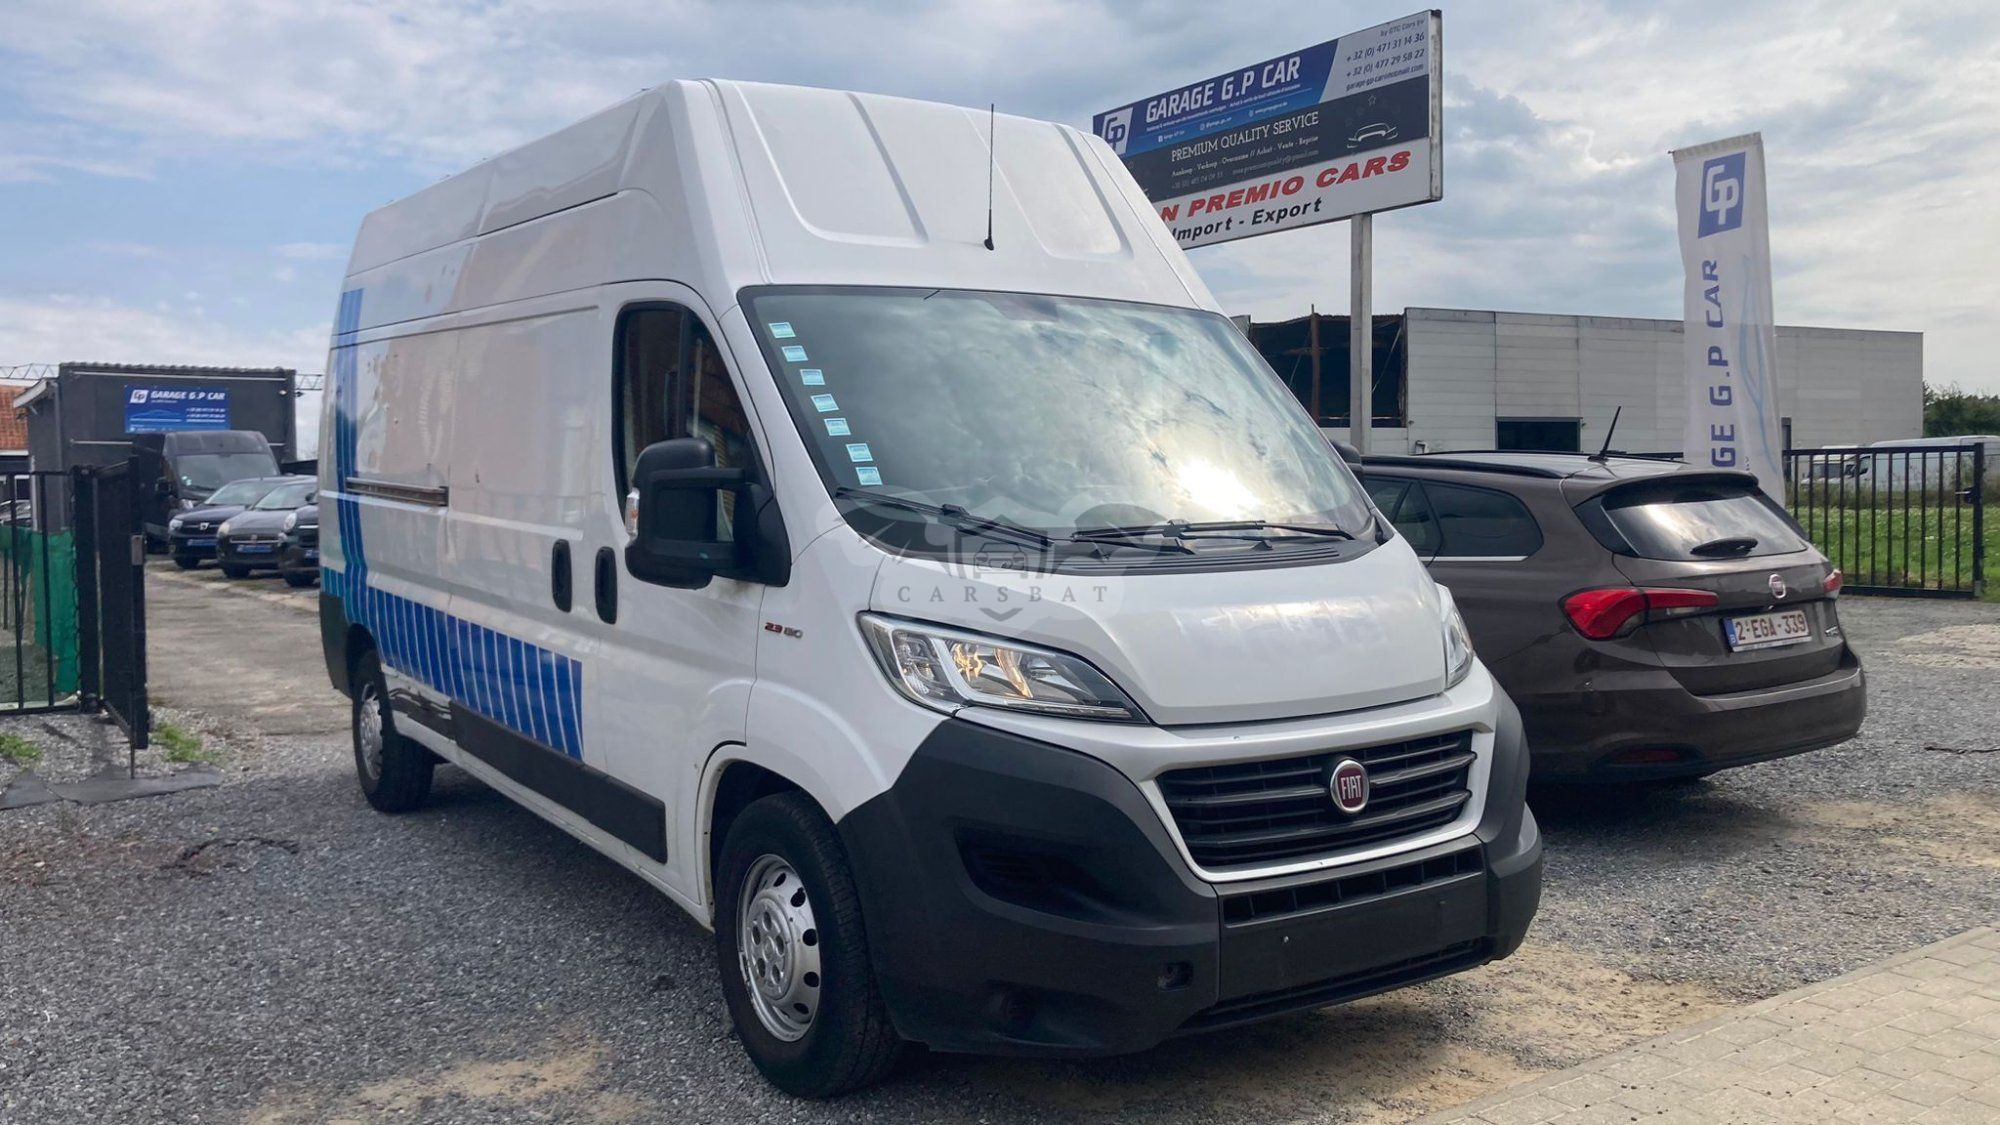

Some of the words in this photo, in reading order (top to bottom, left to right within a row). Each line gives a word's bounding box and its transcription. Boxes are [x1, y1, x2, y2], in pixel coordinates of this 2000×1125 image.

[1353, 50, 1363, 61] 32
[1364, 46, 1375, 59] (0)
[1376, 42, 1391, 53] 471
[1392, 38, 1402, 49] 31
[1414, 32, 1425, 42] 36
[1352, 66, 1362, 76] 32
[1363, 63, 1373, 75] (0)
[1375, 58, 1390, 69] 477
[1391, 55, 1401, 66] 29
[1402, 51, 1413, 62] 58
[1414, 48, 1425, 59] 22
[1146, 82, 1215, 123] GARAGE
[1221, 70, 1255, 100] G.P
[1262, 56, 1301, 88] CAR
[1171, 139, 1219, 162] PREMIUM
[1221, 124, 1270, 149] QUALITY
[1273, 111, 1319, 135] SERVICE
[1277, 141, 1294, 151] Vente
[1187, 175, 1304, 218] PREMIO
[1316, 150, 1412, 188] CARS
[1251, 196, 1322, 226] Export
[1702, 260, 1724, 328] CAR
[150, 390, 187, 399] GARAGE
[207, 392, 225, 400] CAR
[1340, 775, 1362, 801] FIAT
